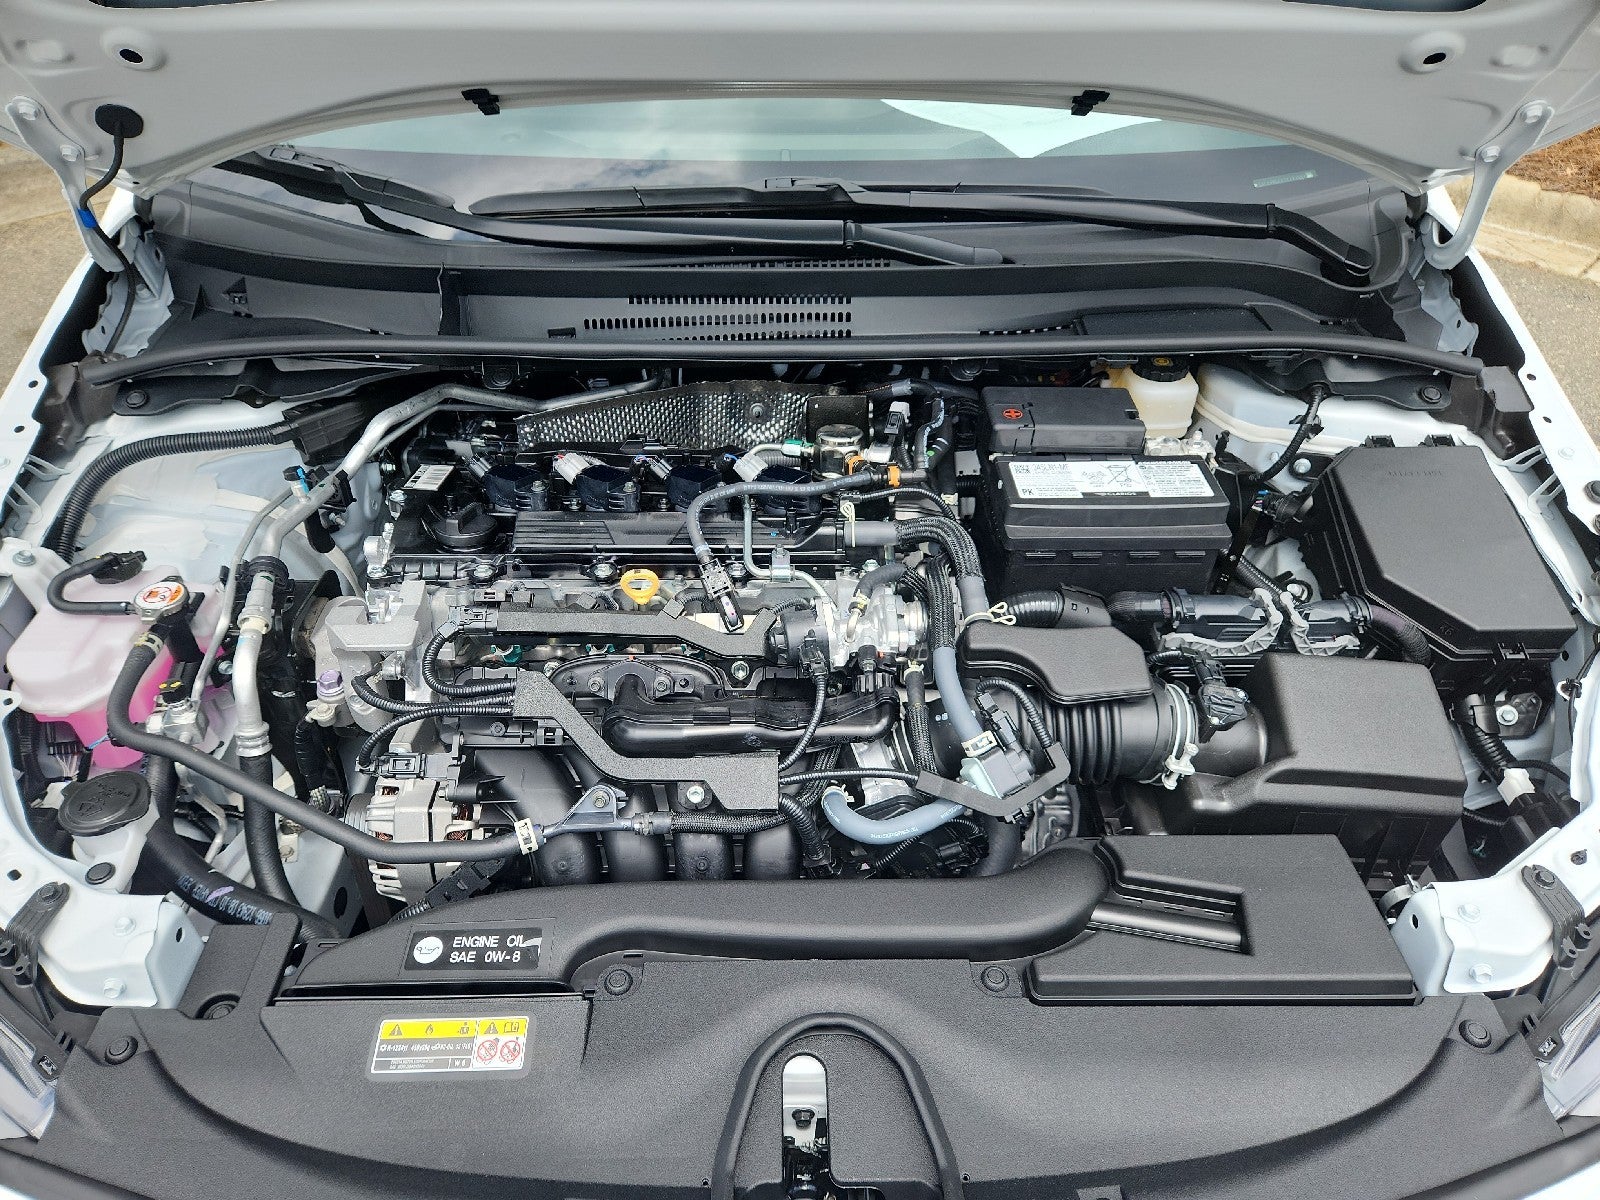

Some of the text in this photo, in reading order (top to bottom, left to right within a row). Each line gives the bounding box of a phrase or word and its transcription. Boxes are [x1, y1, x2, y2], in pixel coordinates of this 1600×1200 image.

[1022, 488, 1034, 496] PK
[452, 934, 525, 948] ENGINE OIL
[449, 950, 521, 963] SAE 0W-8
